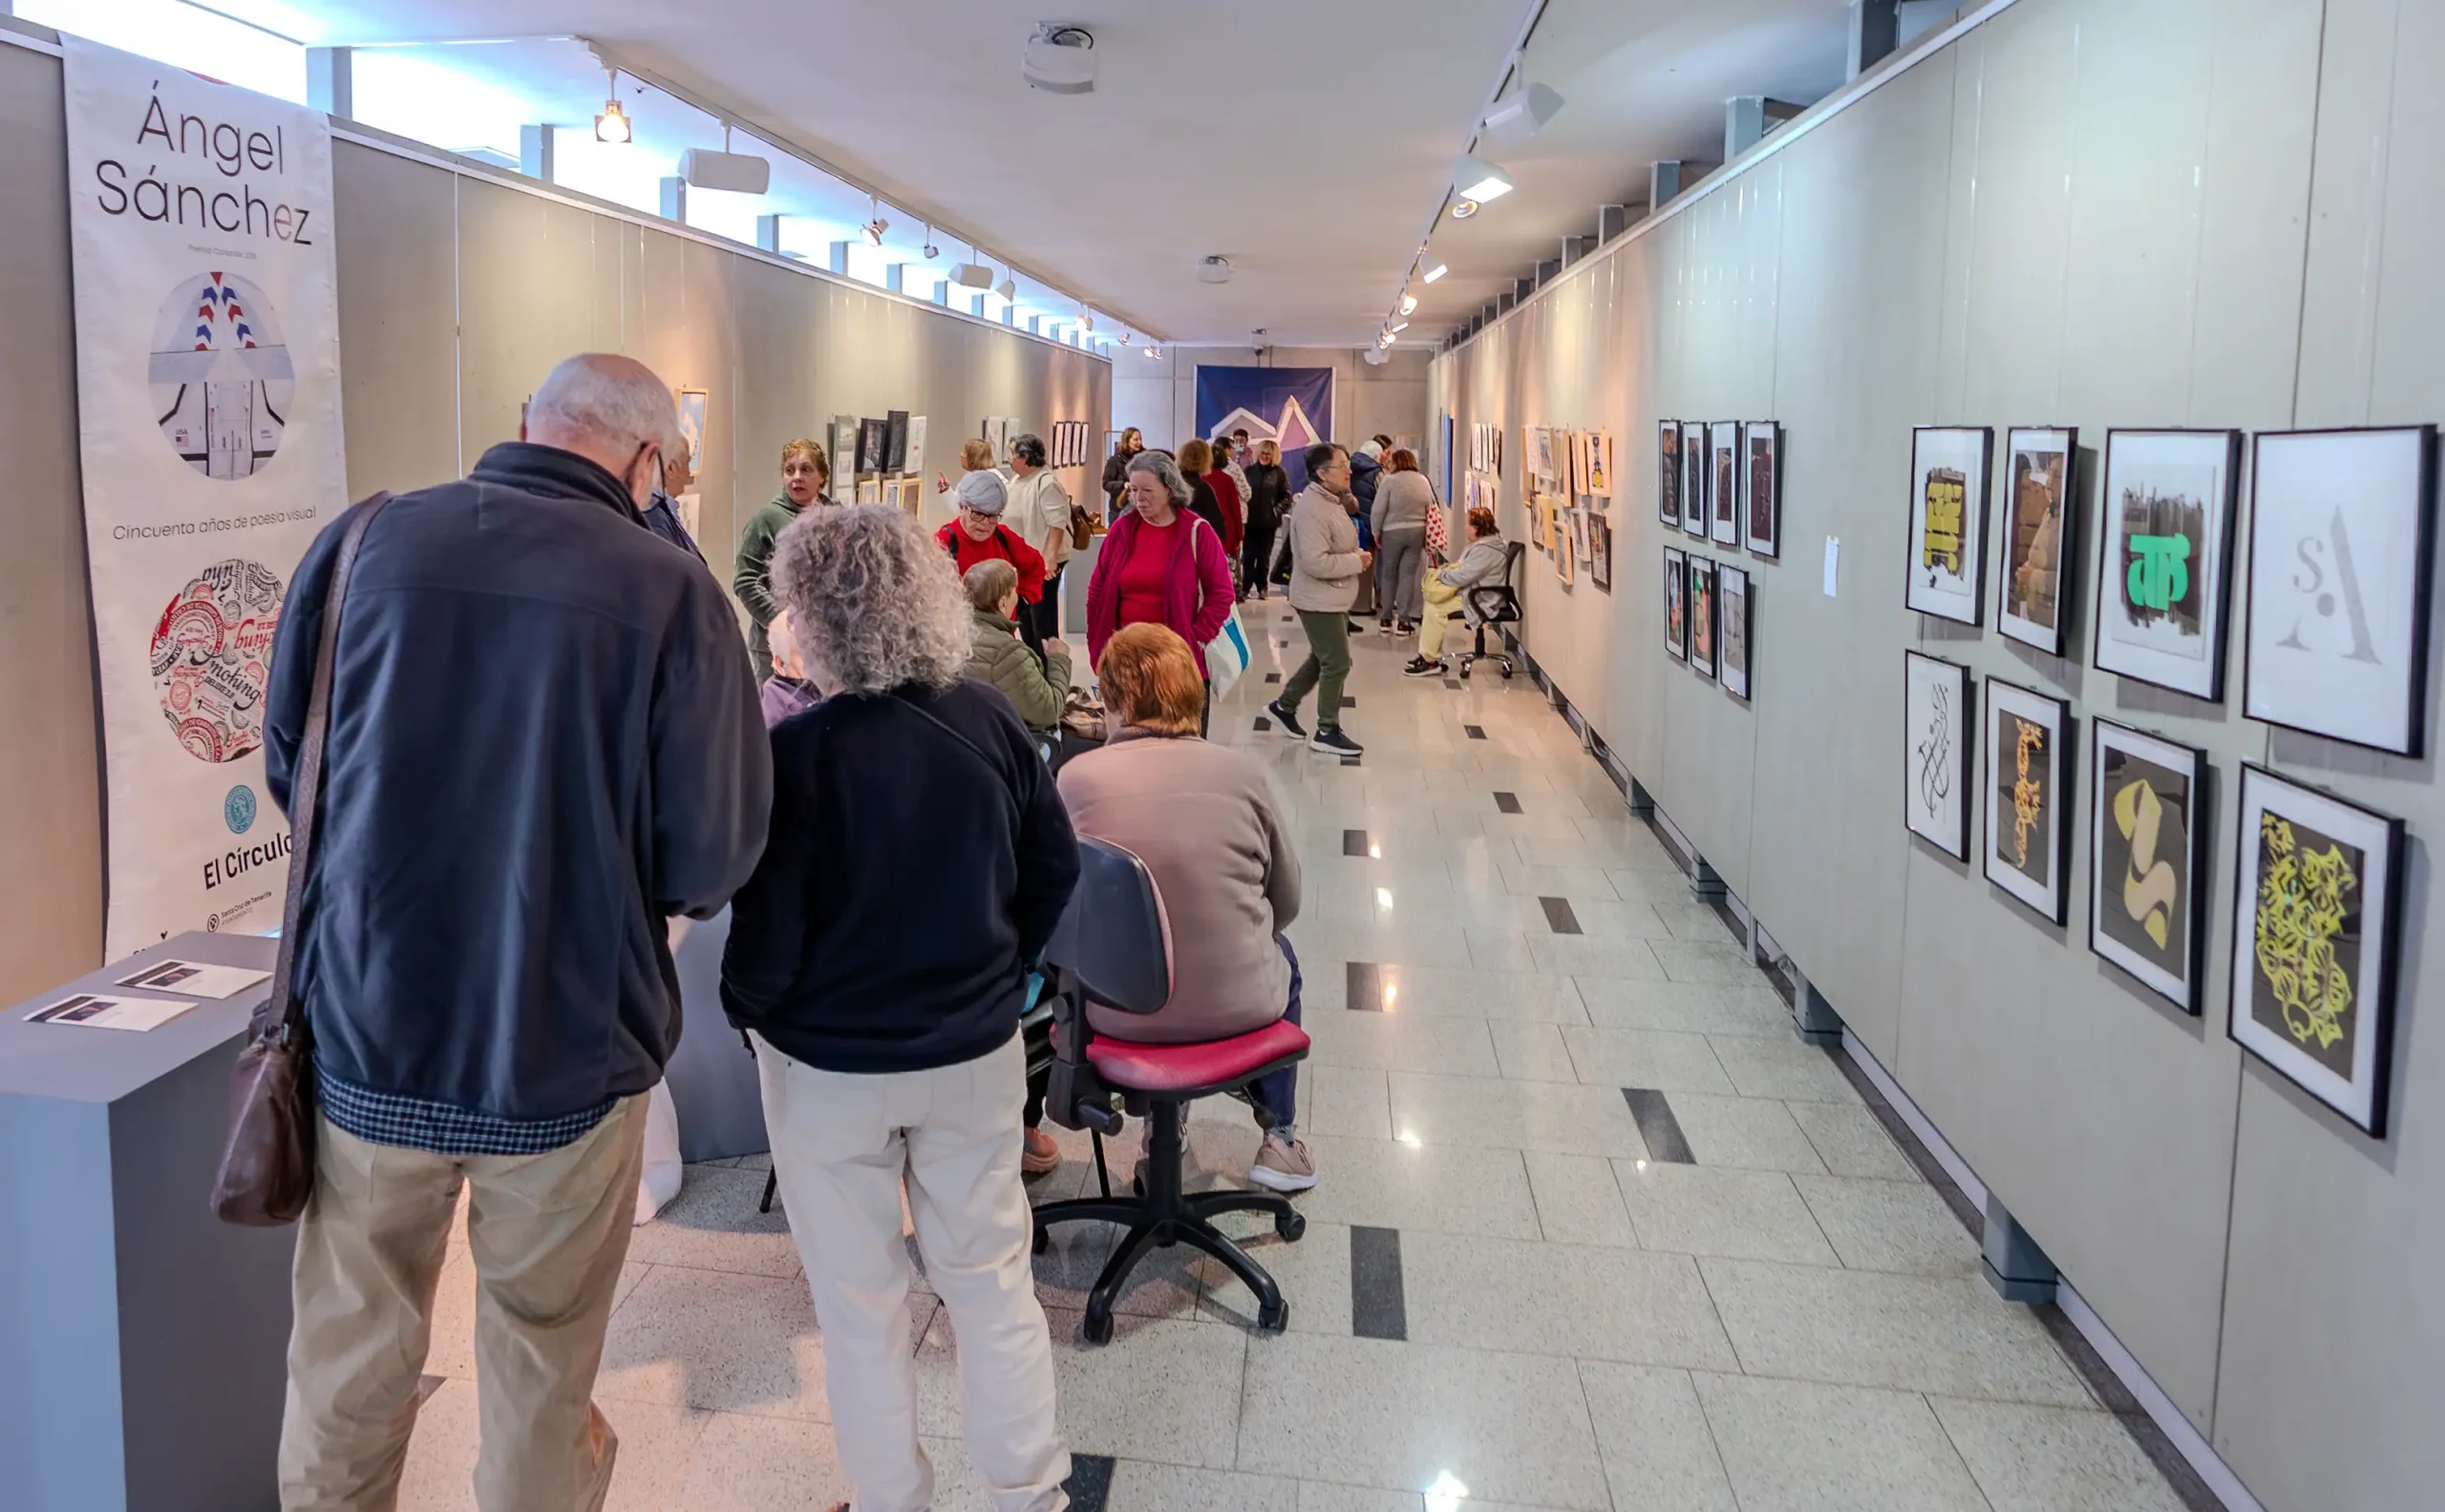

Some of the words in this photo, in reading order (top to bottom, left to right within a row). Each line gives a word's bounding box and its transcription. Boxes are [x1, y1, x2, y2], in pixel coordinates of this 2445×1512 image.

[137, 79, 284, 178] Ángel
[96, 159, 312, 246] Sánchez
[113, 522, 195, 541] Cincuenta
[199, 518, 231, 534] años
[287, 504, 316, 521] visual
[202, 858, 222, 890] El
[224, 832, 292, 879] Círculo
